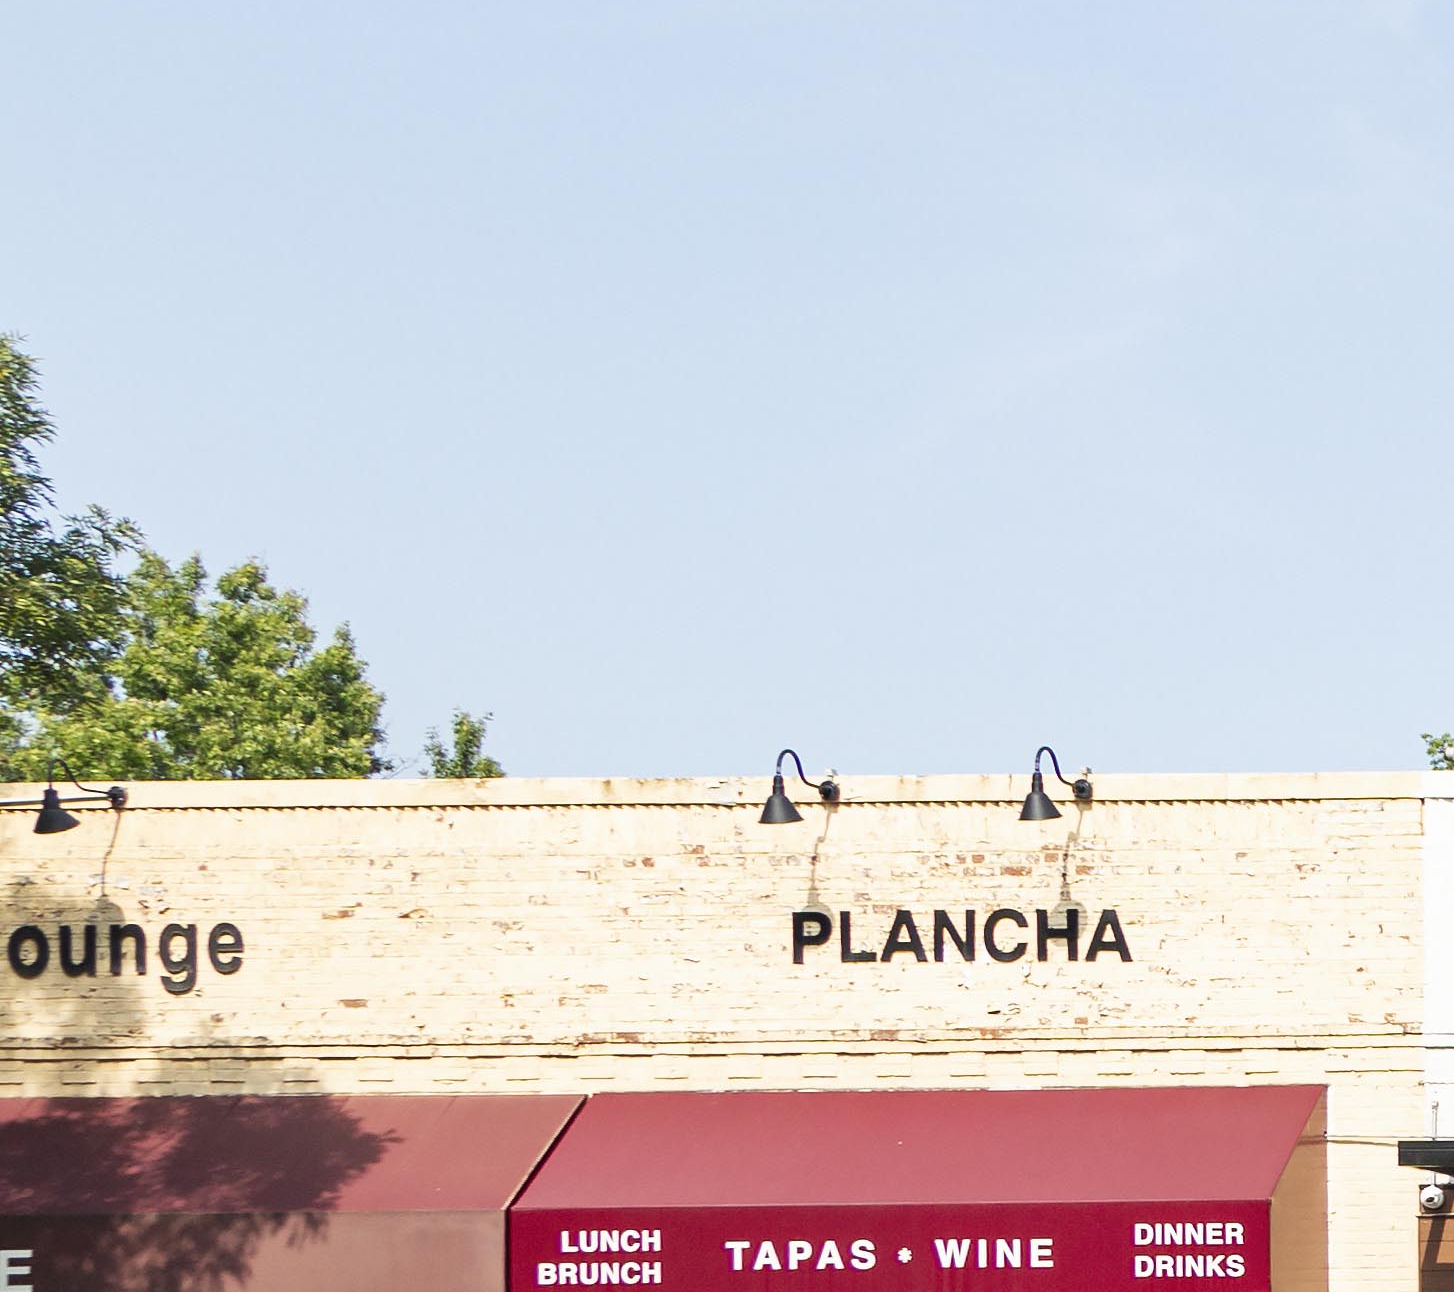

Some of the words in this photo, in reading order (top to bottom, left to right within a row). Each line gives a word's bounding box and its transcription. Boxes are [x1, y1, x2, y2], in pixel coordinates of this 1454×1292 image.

[793, 909, 1133, 965] PLANCHA
[7, 922, 244, 996] ounge
[561, 1229, 661, 1253] LUNCH
[1134, 1222, 1244, 1246] DINNER
[725, 1239, 876, 1271] TAPAS
[935, 1238, 1054, 1268] WINE
[1134, 1254, 1245, 1278] DRINKS
[538, 1261, 662, 1285] BRUNCH
